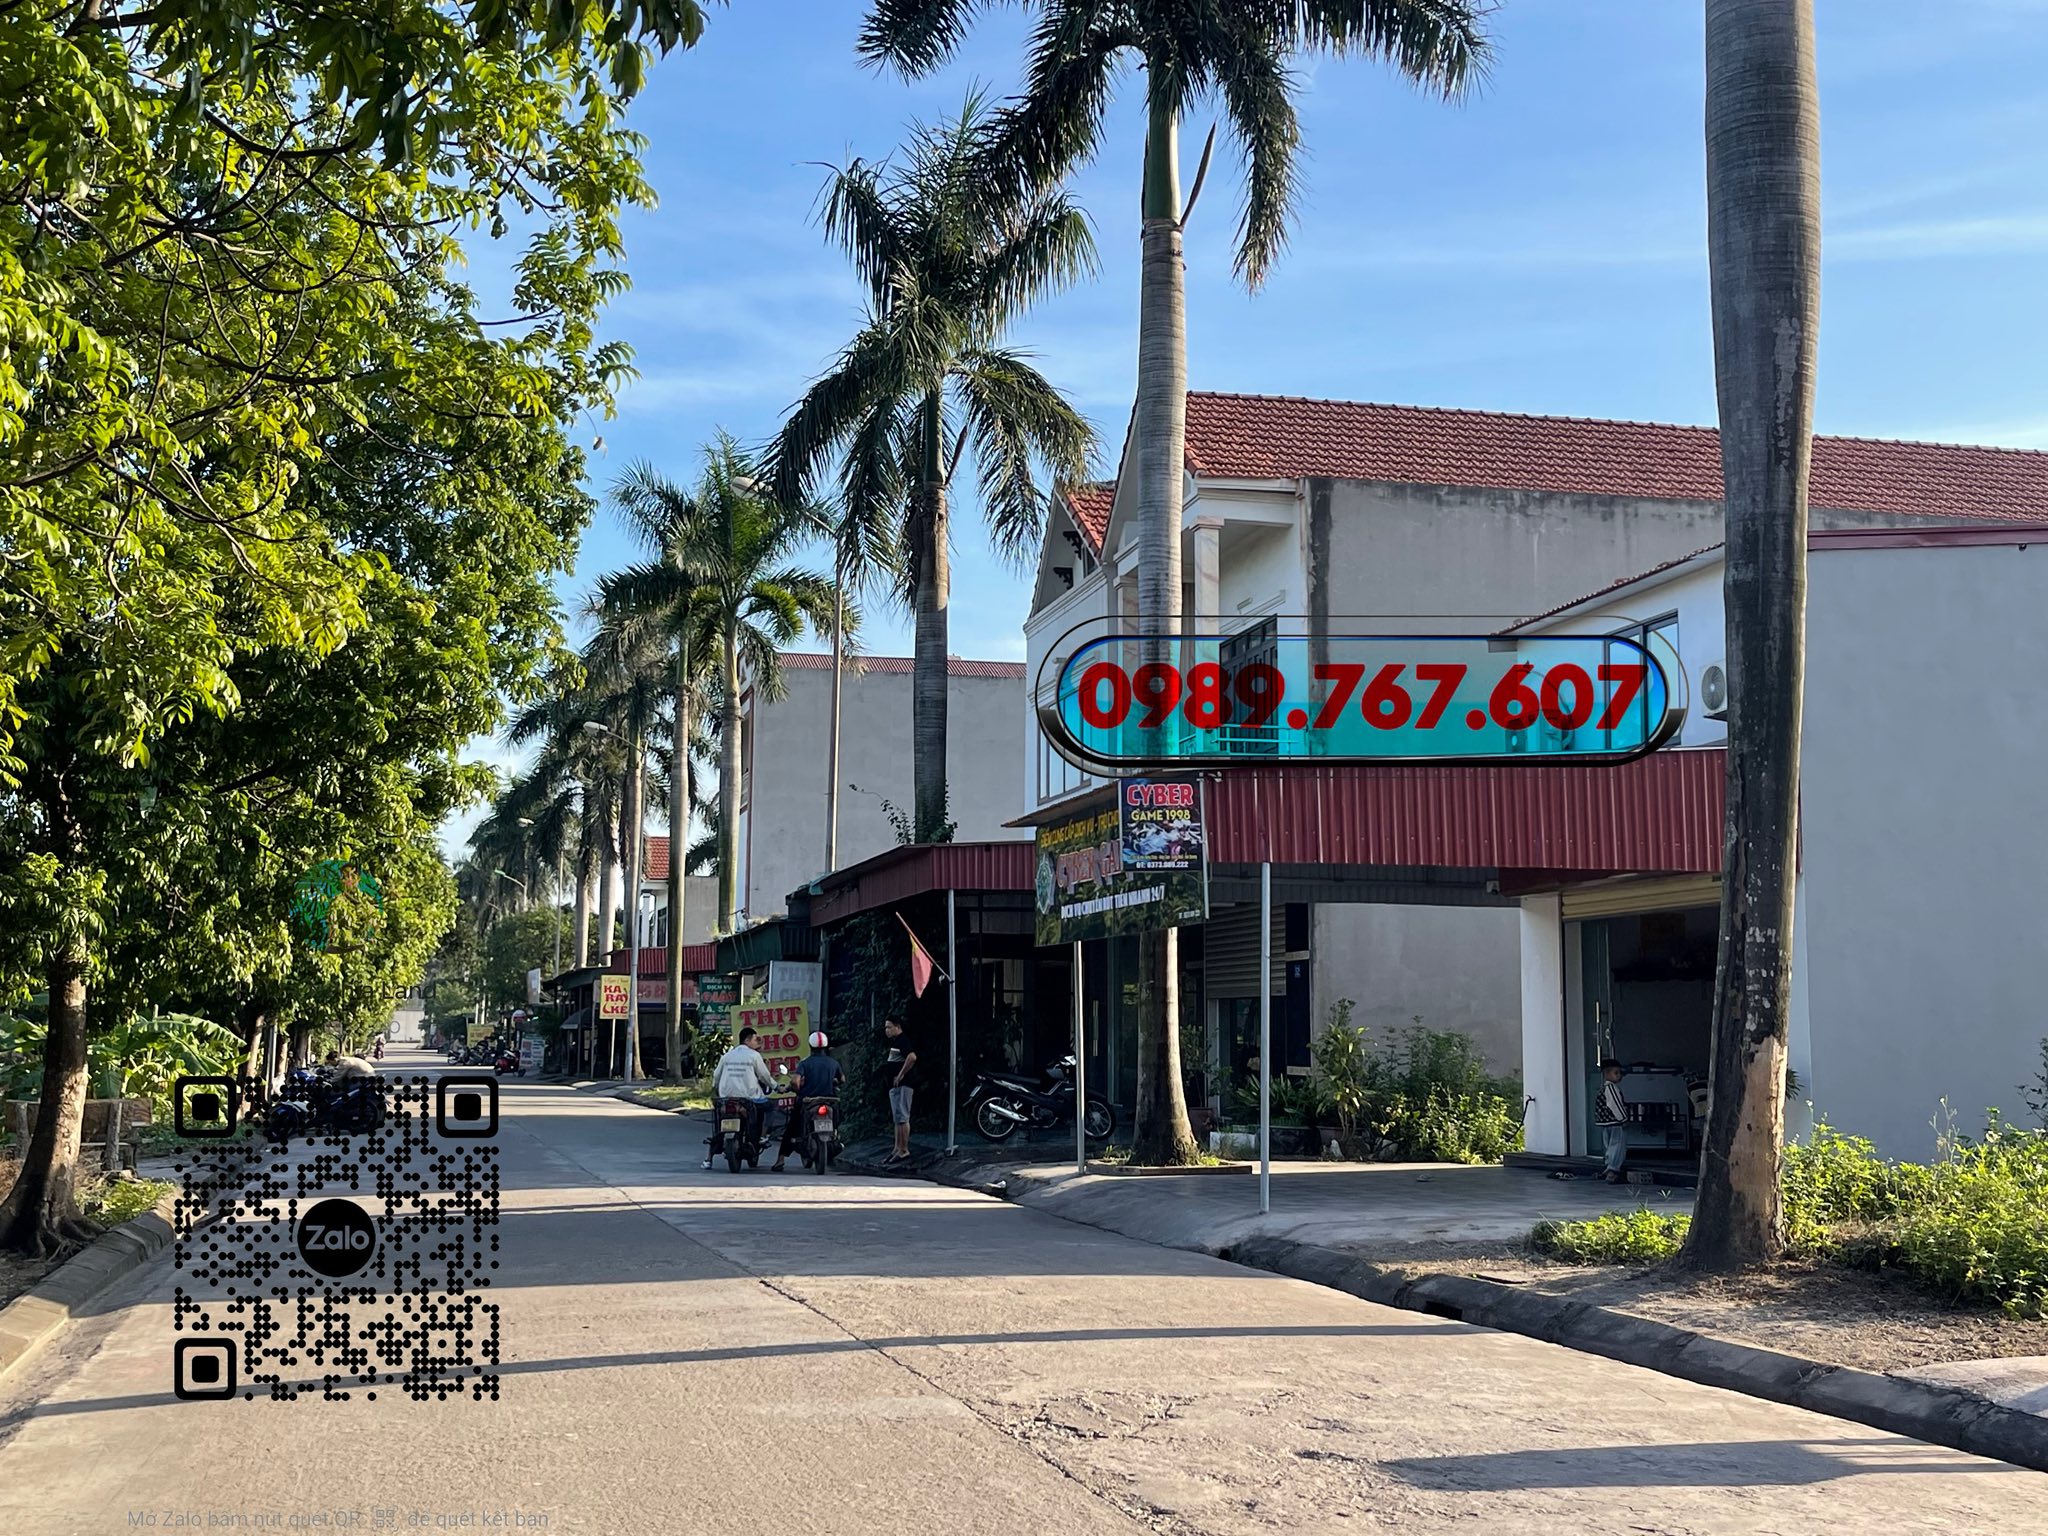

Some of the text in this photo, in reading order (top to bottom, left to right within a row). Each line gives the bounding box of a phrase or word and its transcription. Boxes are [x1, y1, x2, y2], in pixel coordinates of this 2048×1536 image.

[1127, 783, 1194, 807] CYBER
[1131, 809, 1190, 821] GAME 1998
[739, 1006, 803, 1029] THỊT
[756, 1028, 800, 1051] HÓ
